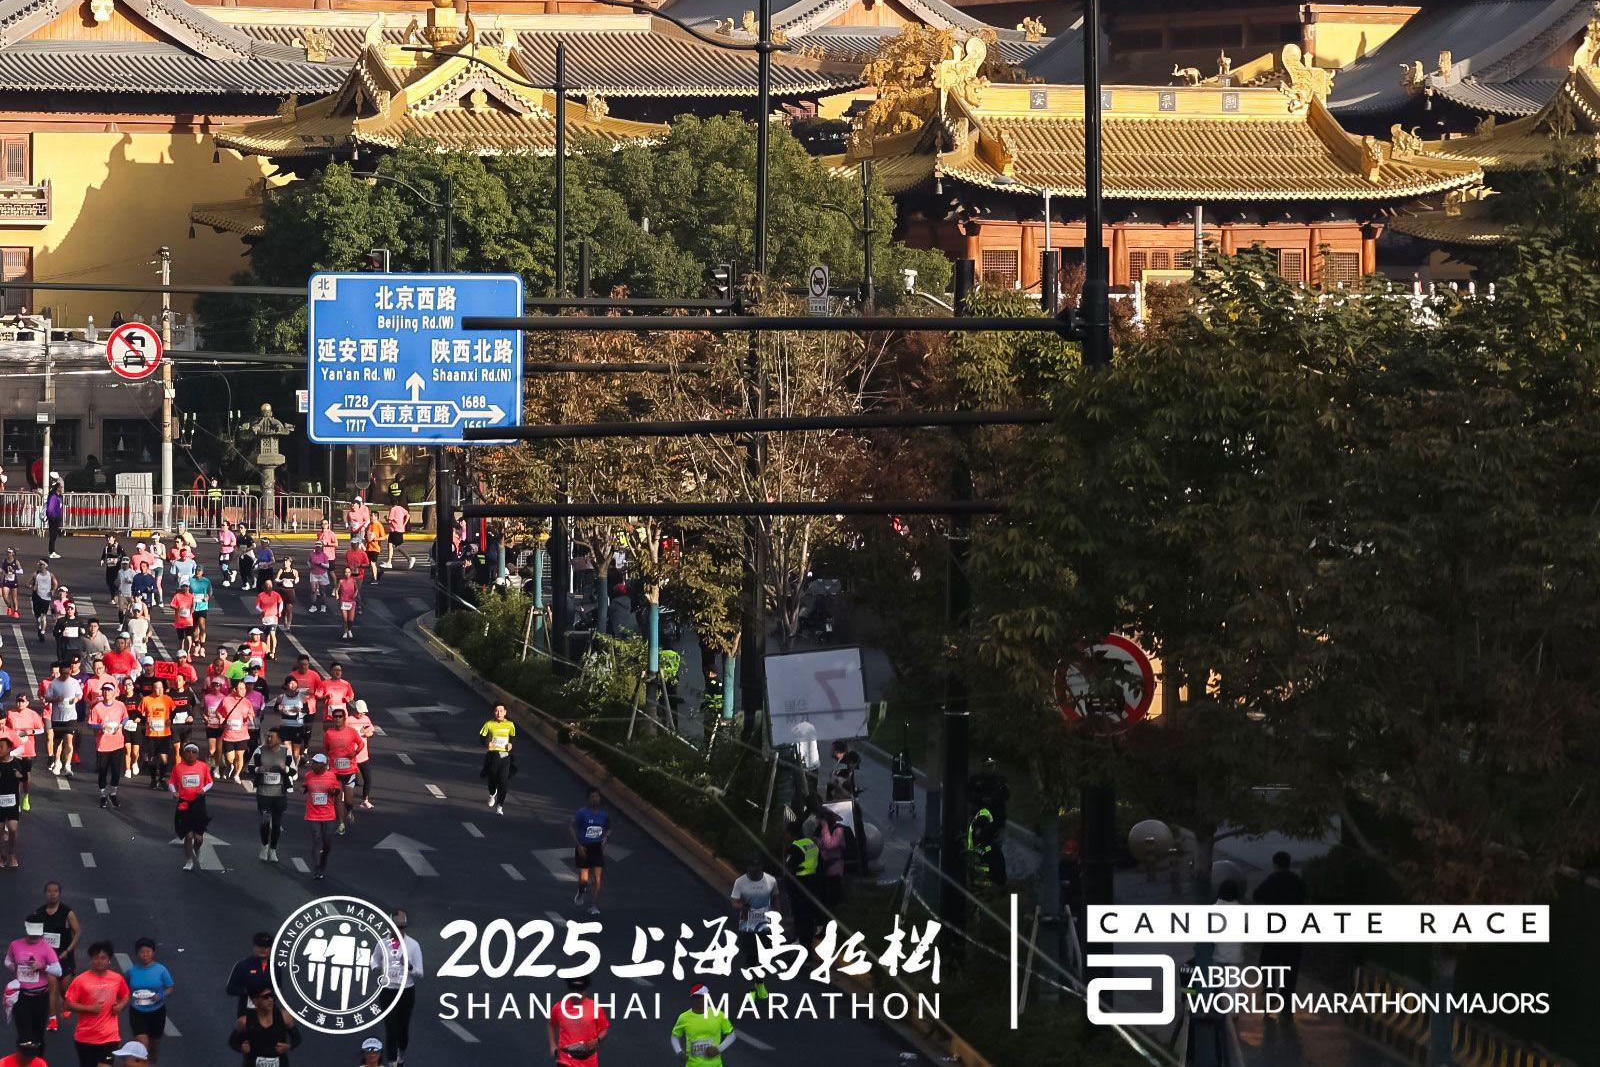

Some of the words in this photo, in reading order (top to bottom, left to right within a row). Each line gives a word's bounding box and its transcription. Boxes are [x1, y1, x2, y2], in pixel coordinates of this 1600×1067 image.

[318, 278, 330, 291] 北
[375, 285, 457, 311] 北京西路
[377, 315, 418, 332] Beijing
[317, 338, 400, 363] 延安西路
[431, 339, 514, 364] 陕西北路
[321, 368, 360, 381] Yan'an
[432, 368, 478, 382] Shaanxi
[344, 395, 369, 408] 1728
[461, 396, 486, 408] 1688
[380, 406, 450, 424] 南京西路
[345, 419, 366, 432] 1717
